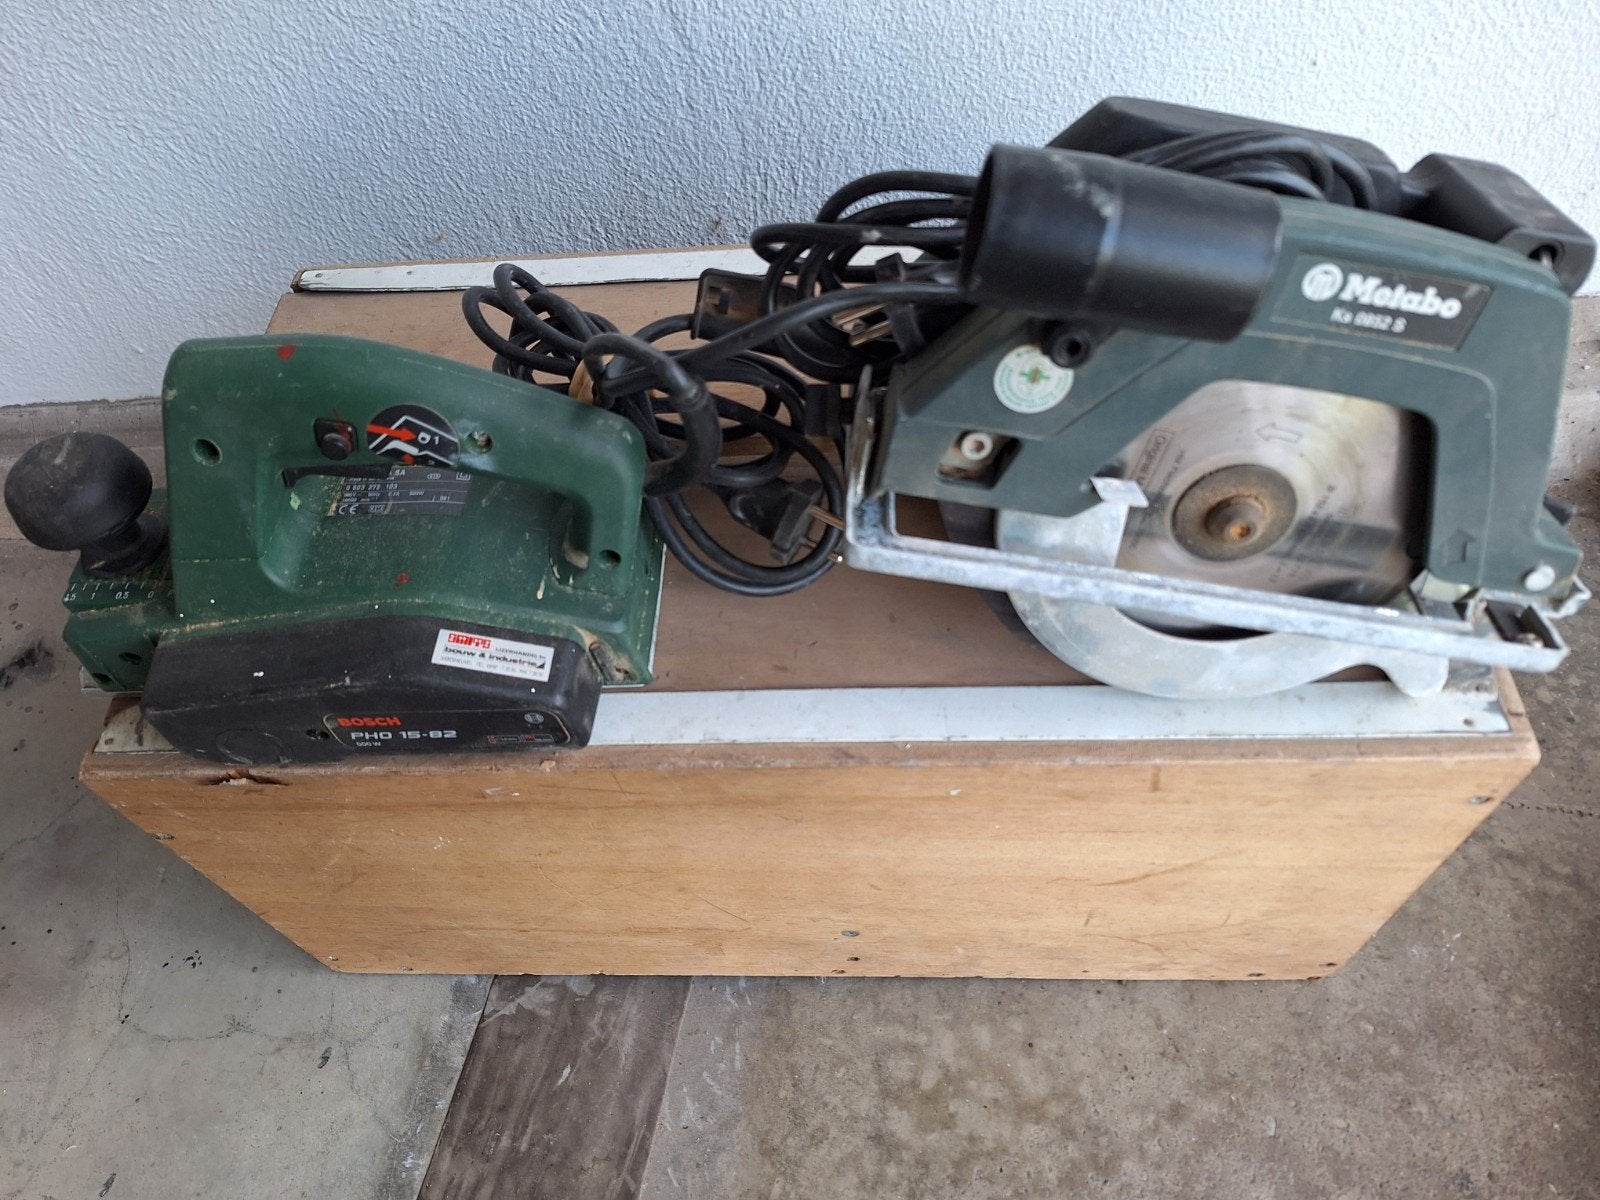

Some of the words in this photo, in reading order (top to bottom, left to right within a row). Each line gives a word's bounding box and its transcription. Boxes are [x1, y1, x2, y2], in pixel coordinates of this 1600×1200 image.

[1338, 273, 1462, 319] Metabo
[115, 591, 130, 600] 0.5
[444, 646, 476, 658] bouw
[489, 654, 538, 668] industrie
[338, 717, 401, 727] BOSCH
[350, 731, 393, 741] PHO
[400, 730, 458, 740] 15-82
